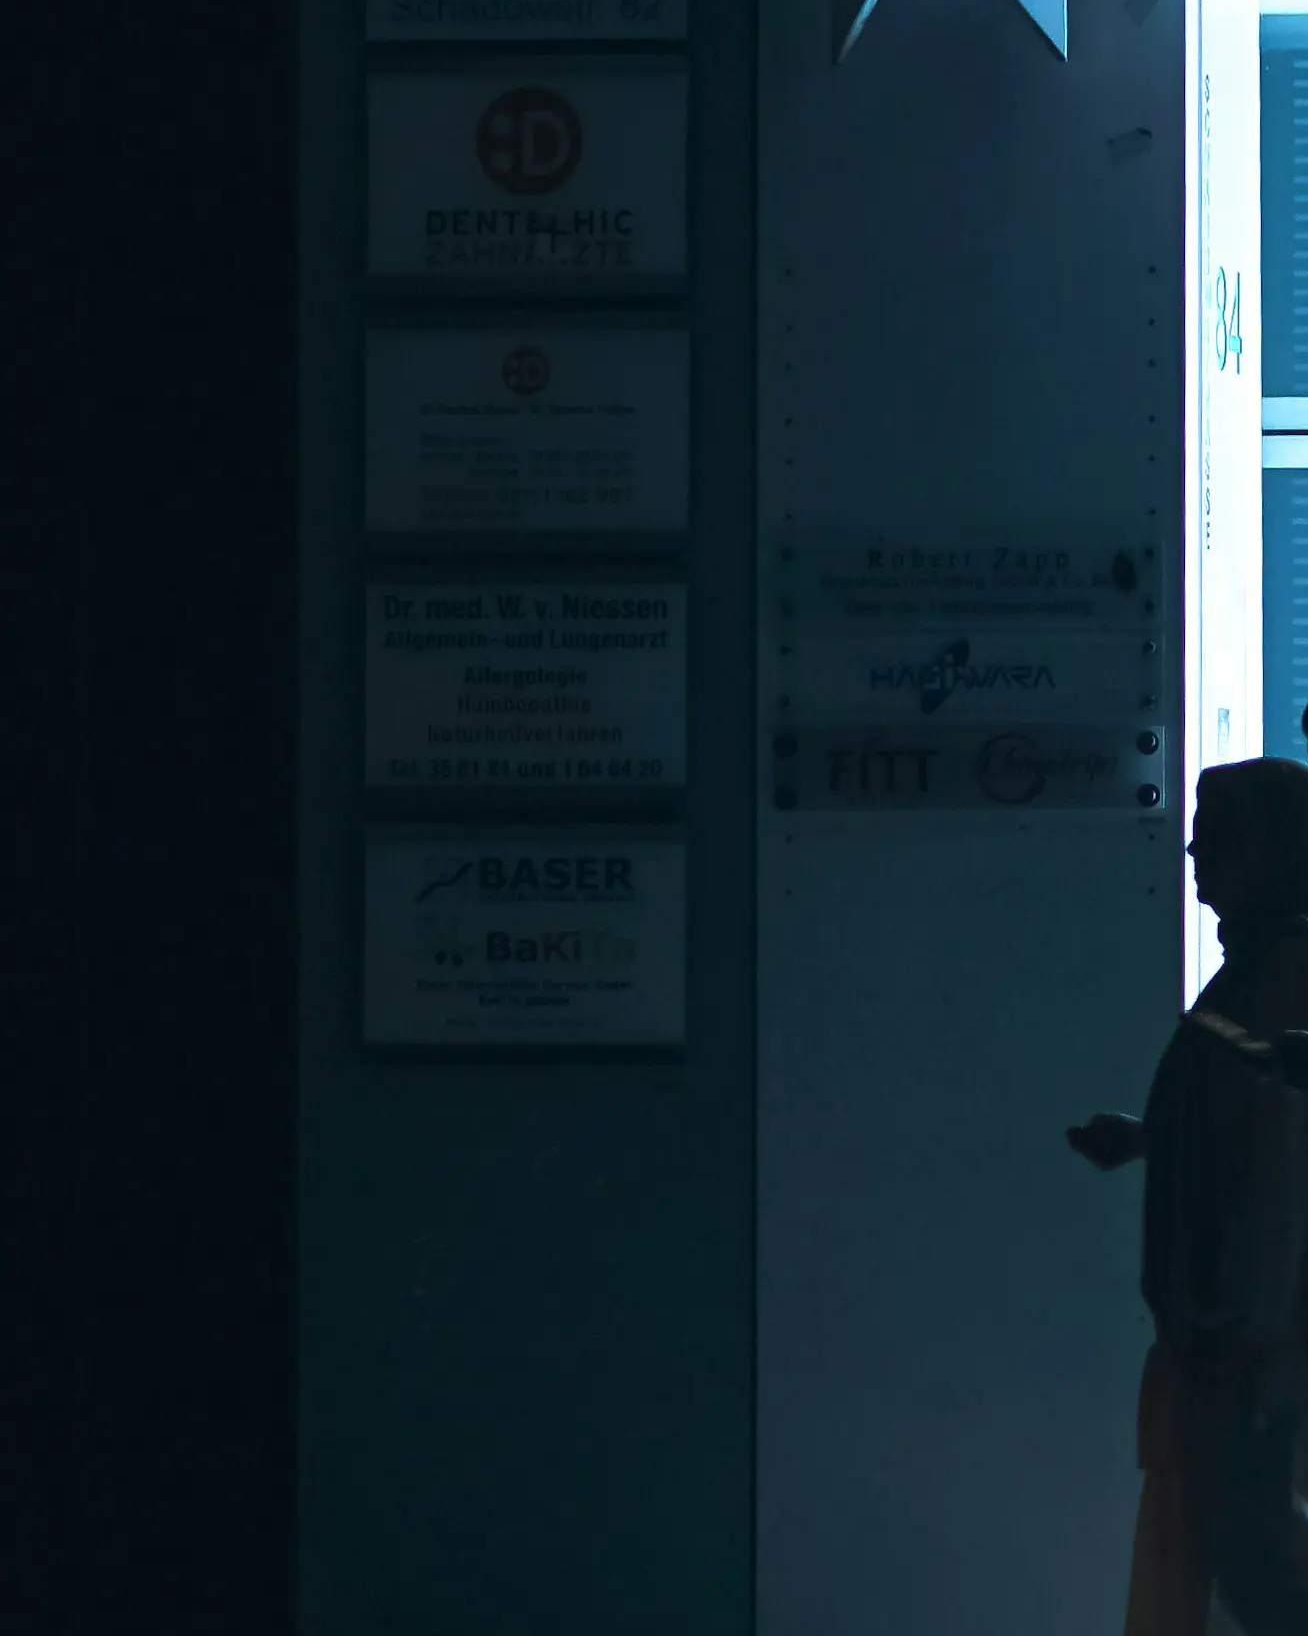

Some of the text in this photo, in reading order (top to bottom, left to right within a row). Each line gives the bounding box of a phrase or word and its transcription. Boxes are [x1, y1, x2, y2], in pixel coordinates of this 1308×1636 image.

[383, 594, 418, 621] Dr.
[425, 594, 491, 621] med.
[496, 594, 528, 621] W.
[561, 594, 668, 621] Niessen
[505, 629, 543, 649] und
[549, 629, 668, 653] Lungenarzt
[516, 758, 557, 779] und
[478, 857, 636, 891] BASER
